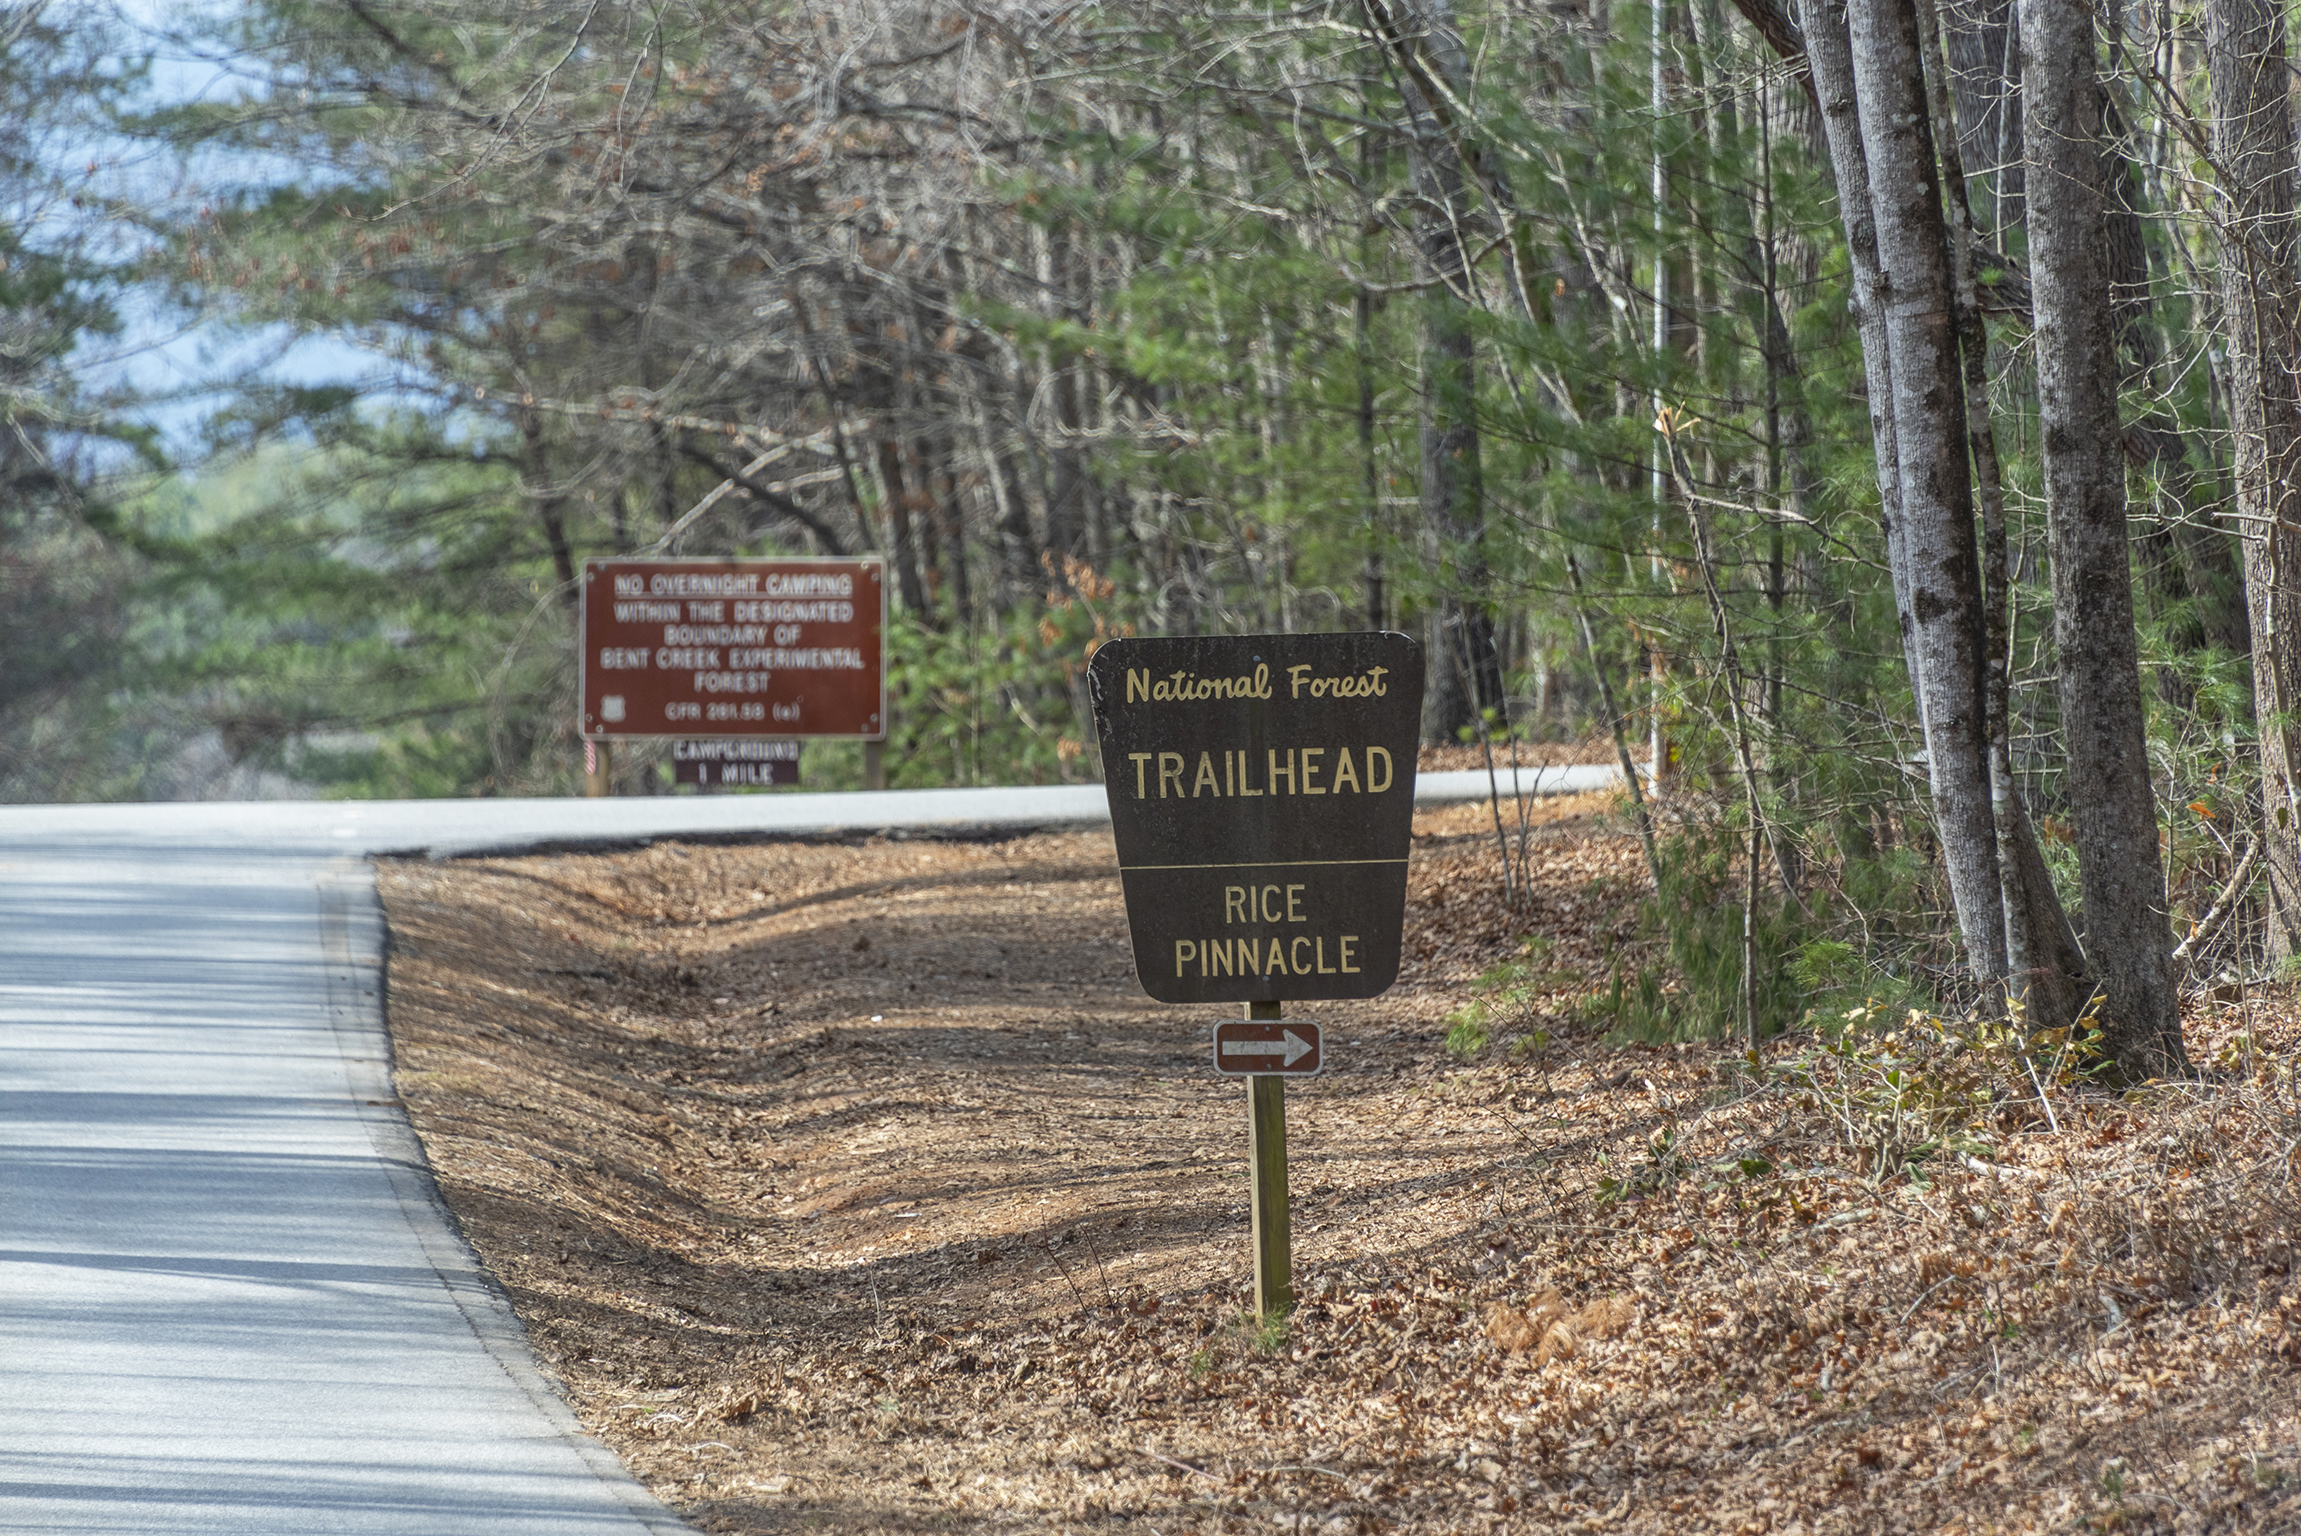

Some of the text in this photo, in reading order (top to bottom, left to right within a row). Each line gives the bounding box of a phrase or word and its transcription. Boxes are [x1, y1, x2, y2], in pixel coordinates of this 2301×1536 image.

[614, 573, 852, 595] NO OVERNIGHT CAMPING
[614, 601, 853, 622] WITHIN THE DESIGNATED
[664, 624, 801, 645] BOUNDARY OF
[601, 647, 865, 669] BENT CREEK EXPERIMENTAL
[694, 671, 769, 692] FOREST
[1126, 663, 1388, 703] National Forest
[665, 702, 700, 720] CFR
[699, 763, 773, 784] 1 MILE
[1128, 746, 1392, 798] TRAILHEAD
[1225, 884, 1306, 923] RICE
[1175, 935, 1360, 977] PINNACLE
